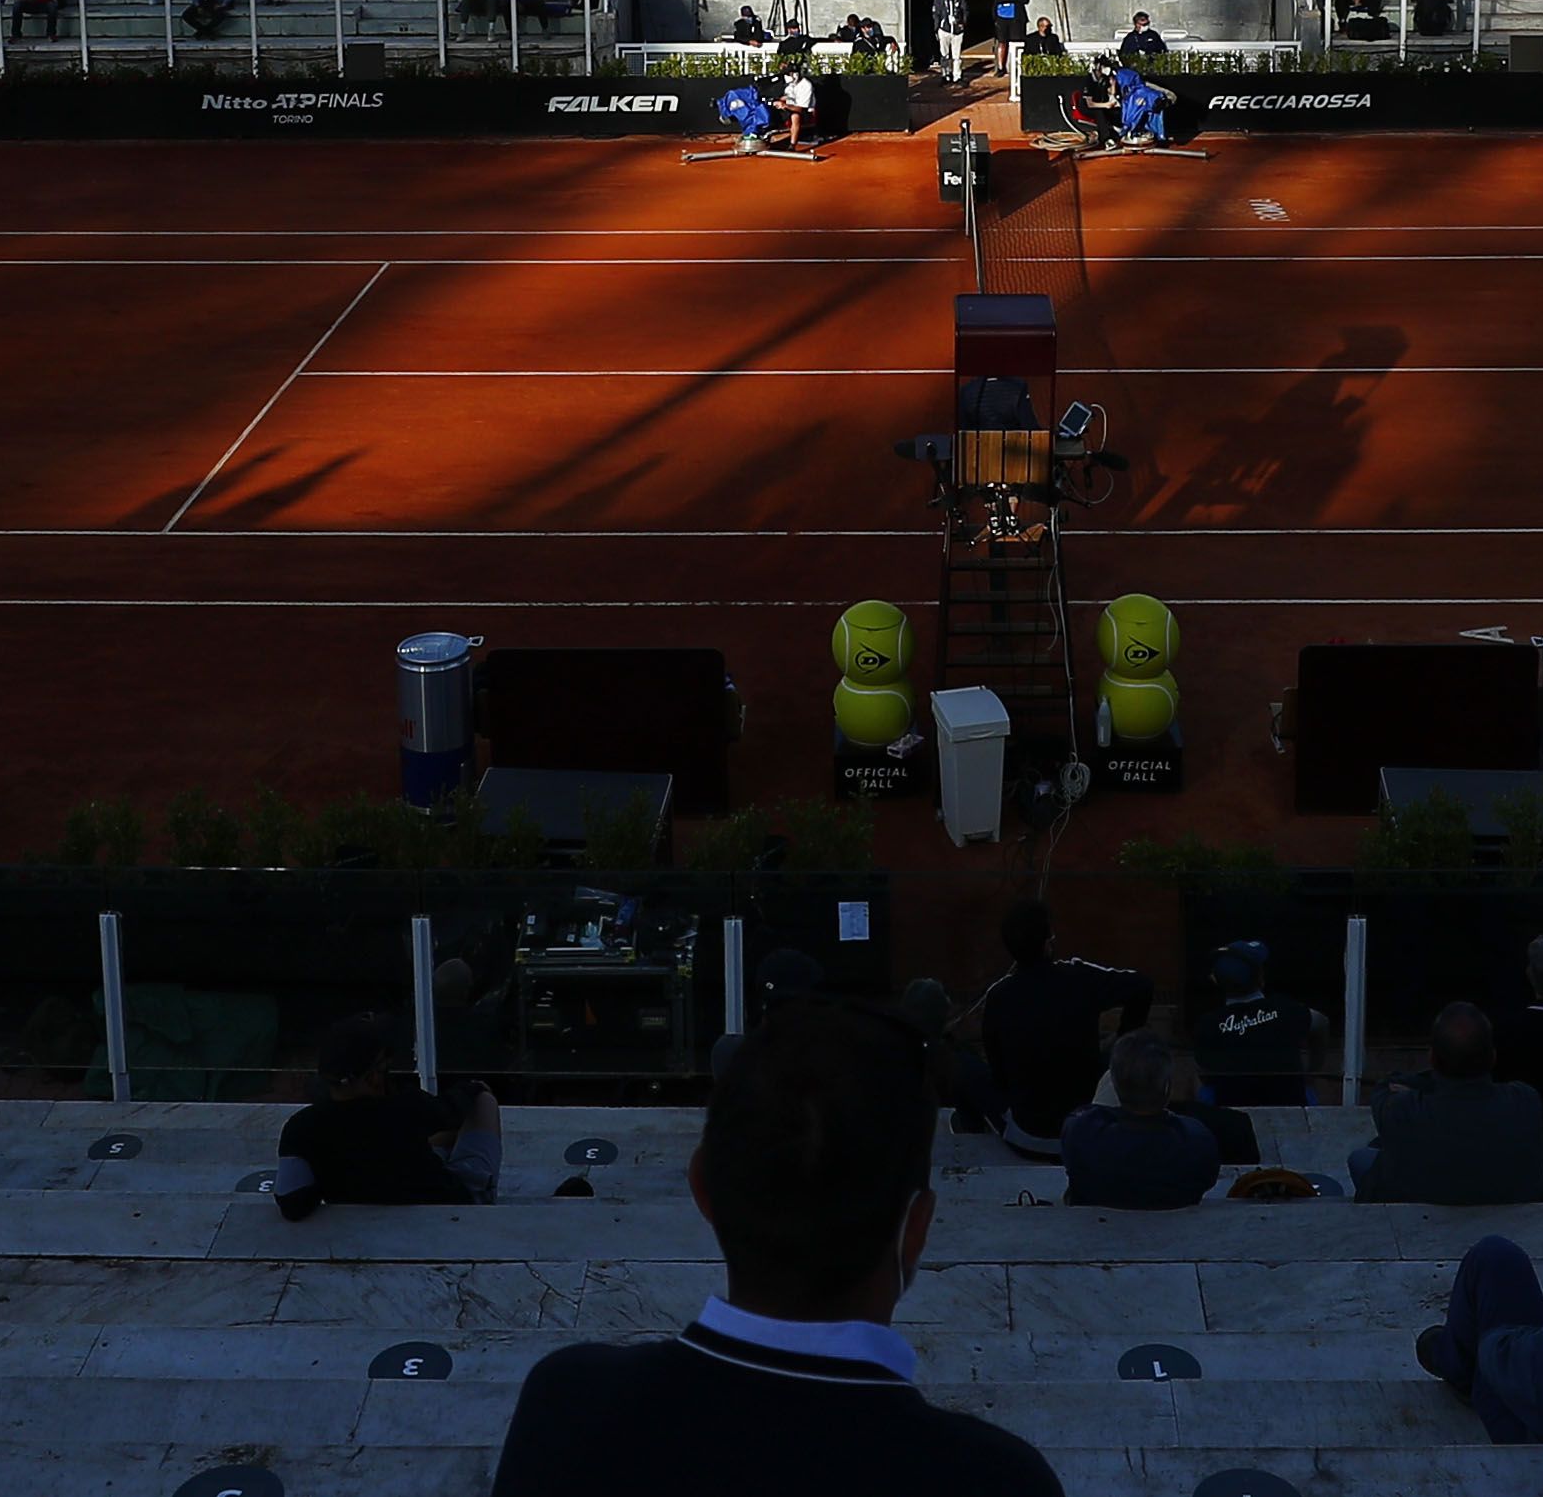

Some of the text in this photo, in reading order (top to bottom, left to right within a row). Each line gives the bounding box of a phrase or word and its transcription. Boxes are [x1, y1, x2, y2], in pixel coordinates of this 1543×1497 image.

[201, 92, 384, 110] Nitto ATP FINALS
[545, 95, 679, 113] FALKEN
[1208, 94, 1372, 110] FRECCIAROSSA
[272, 114, 314, 124] TORINO
[844, 767, 908, 778] OFFICIAL
[1108, 760, 1171, 771] OFFICIAL
[1123, 772, 1157, 782] BALL
[110, 1141, 124, 1155] 5
[585, 1146, 599, 1160] 3
[257, 1179, 274, 1193] 3
[401, 1357, 425, 1377] 3
